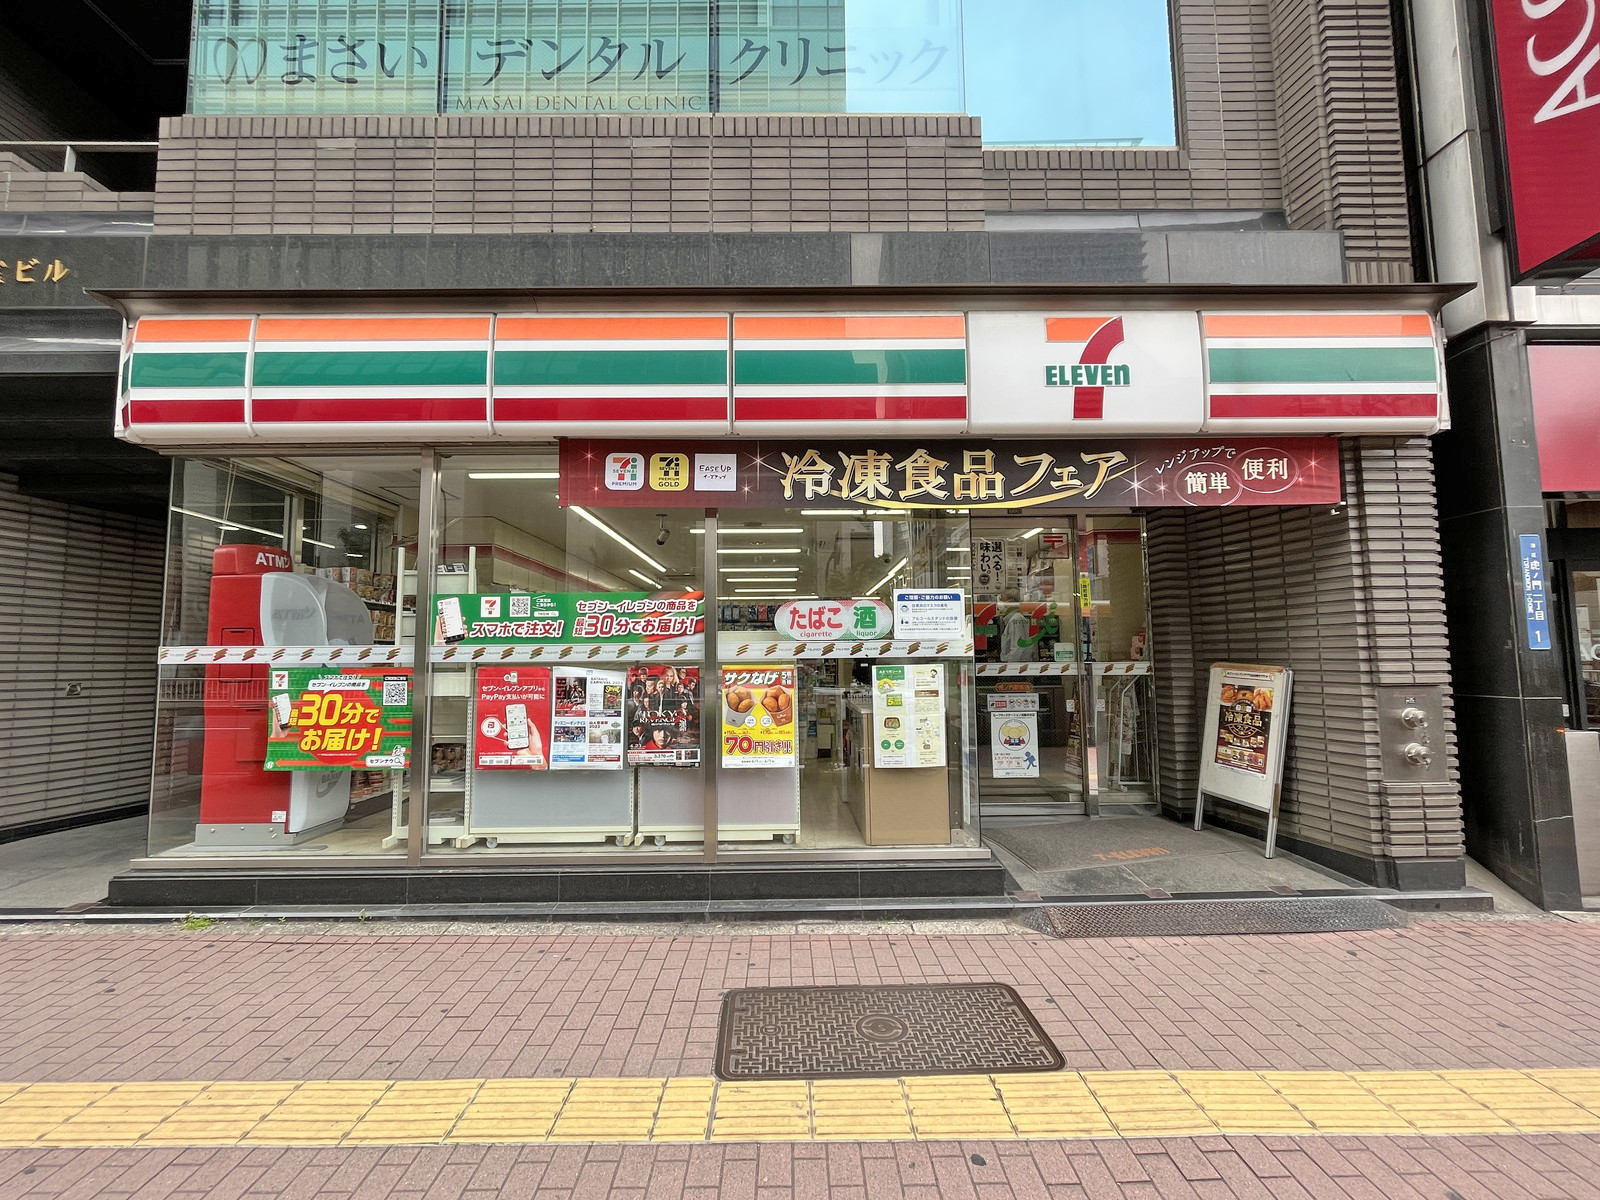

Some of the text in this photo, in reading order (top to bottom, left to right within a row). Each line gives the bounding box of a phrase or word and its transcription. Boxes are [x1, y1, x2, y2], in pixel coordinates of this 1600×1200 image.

[279, 34, 950, 86] まさい デンタル クリニック
[455, 95, 702, 111] MASAI DENTAL CLINIC
[1154, 445, 1237, 475] レンジアップで
[1241, 457, 1289, 481] 便利
[779, 448, 1130, 501] 冷凍食品フェア
[1184, 471, 1231, 495] 簡単
[255, 552, 285, 569] ATM
[470, 621, 563, 636] スマホで注文!
[789, 605, 843, 630] たばこ
[853, 605, 877, 630] 酒
[800, 630, 833, 638] cigarette
[856, 630, 877, 638] liquor
[1535, 629, 1542, 643] 1
[724, 671, 780, 685] サクなげ
[300, 727, 383, 751] お届け!
